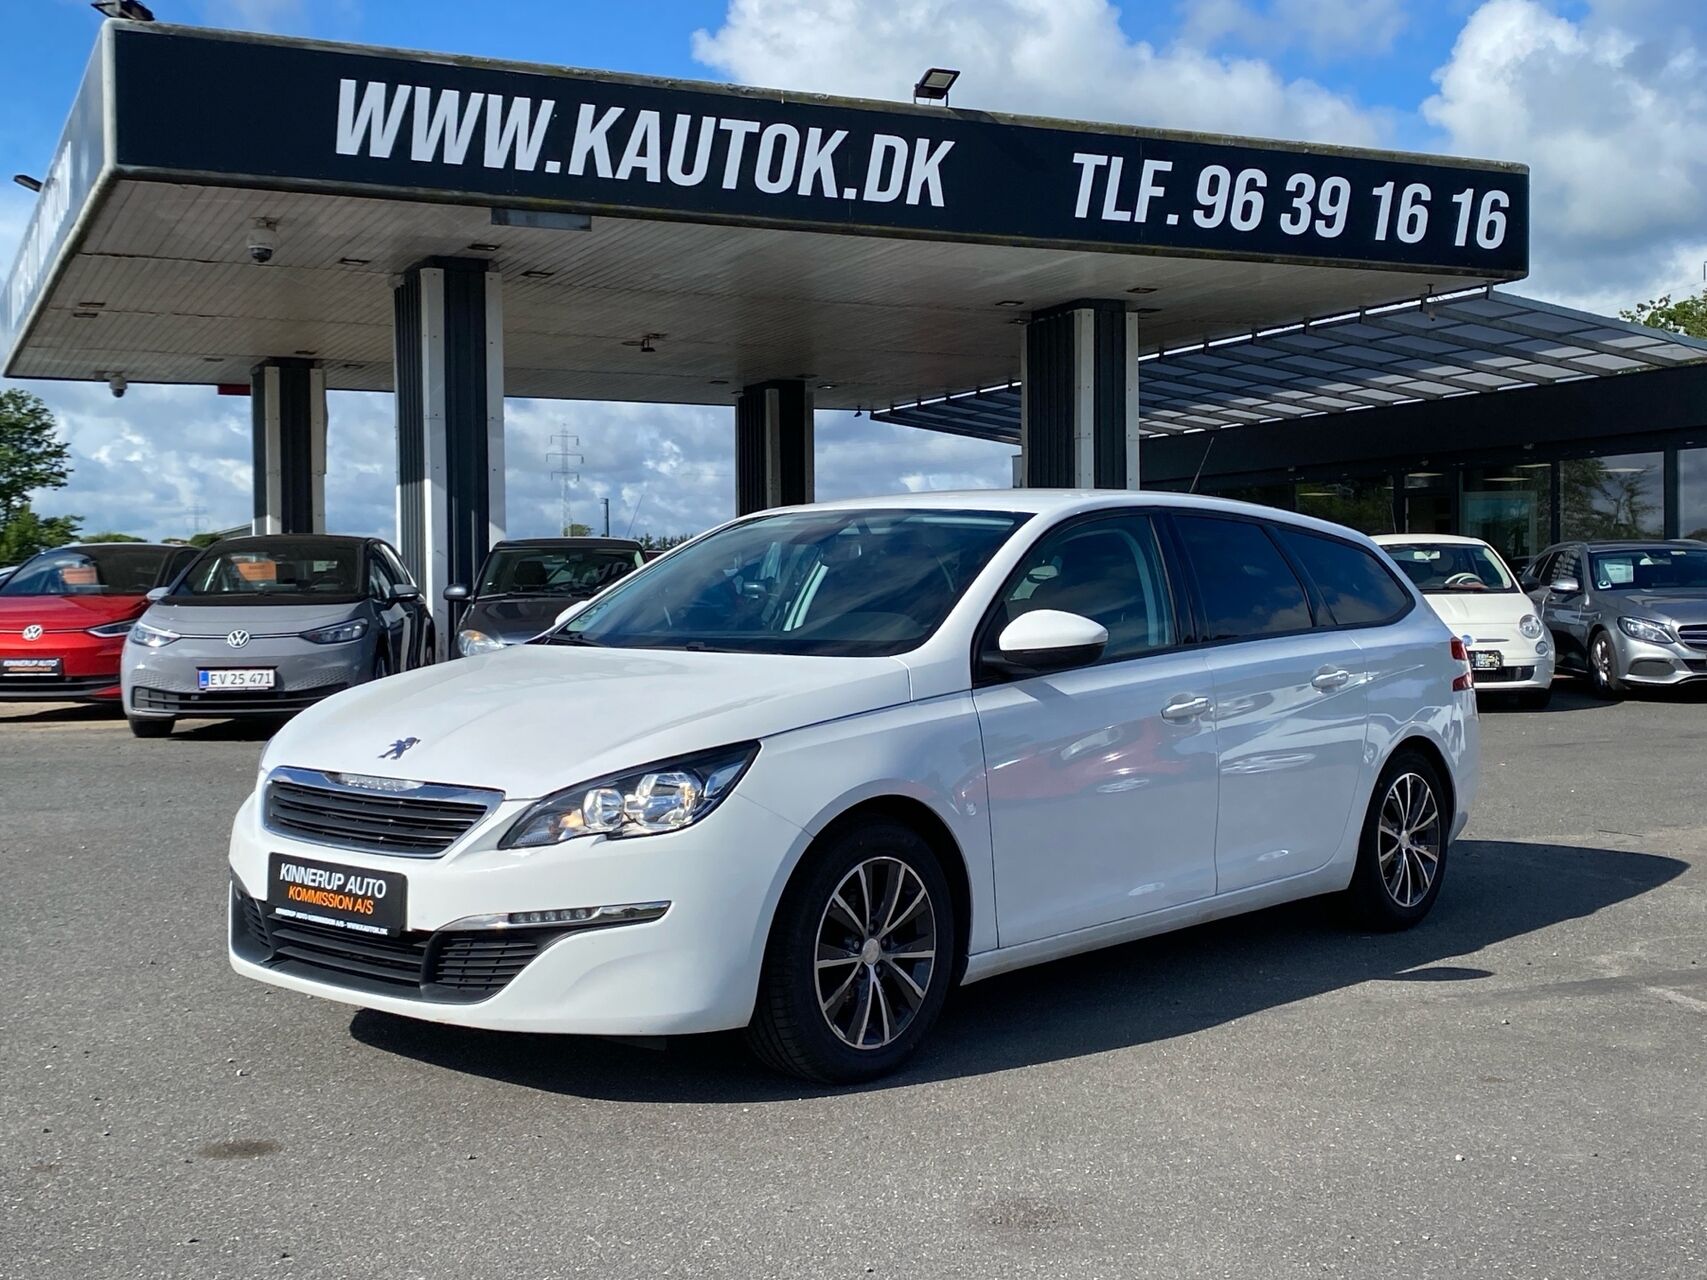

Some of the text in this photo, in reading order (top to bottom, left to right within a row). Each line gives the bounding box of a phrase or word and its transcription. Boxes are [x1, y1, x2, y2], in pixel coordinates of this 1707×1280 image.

[336, 78, 955, 208] WWW.KAUTOK.DK
[1073, 152, 1509, 249] TLF. 96 39 16 16
[210, 672, 272, 685] EV 25 471
[280, 862, 387, 899] KINNERUP AUTO
[288, 885, 374, 915] KOMMISSION A/S
